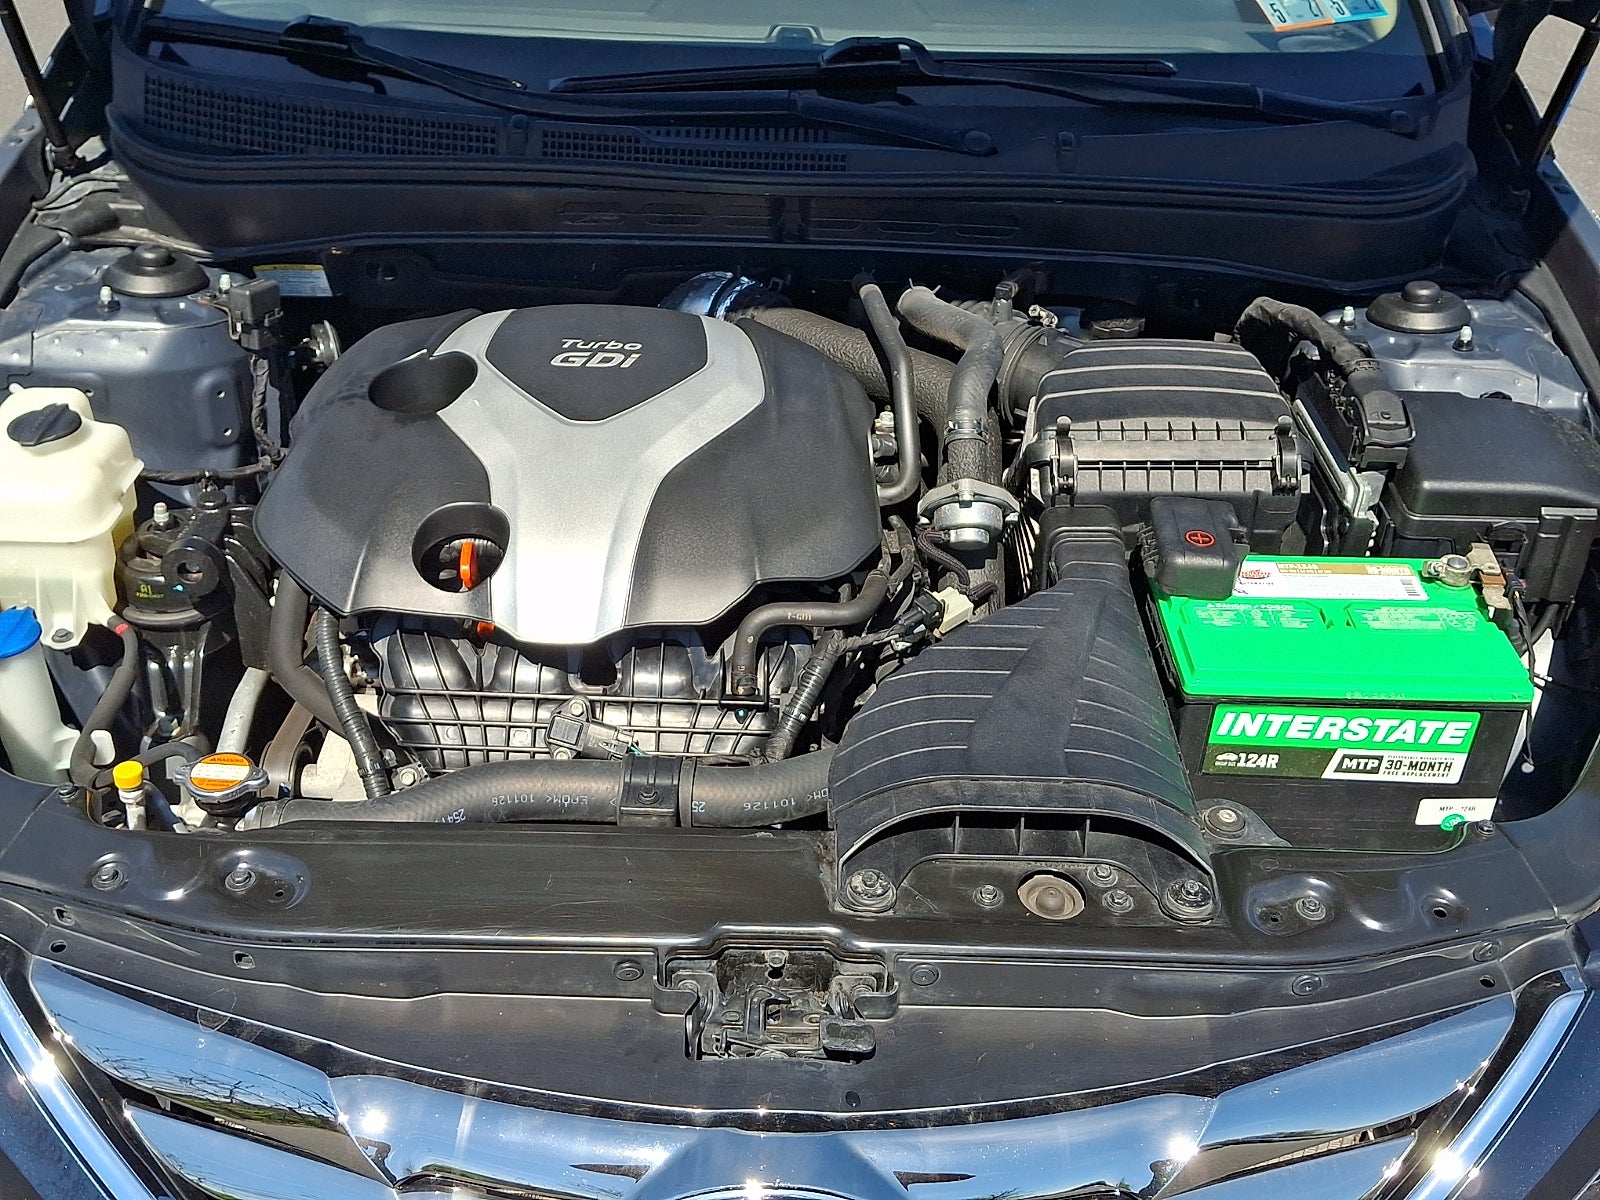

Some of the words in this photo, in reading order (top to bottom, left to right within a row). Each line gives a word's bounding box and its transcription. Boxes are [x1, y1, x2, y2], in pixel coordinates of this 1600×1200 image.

[561, 338, 642, 350] Turbo
[550, 351, 642, 368] GDi
[1216, 711, 1473, 746] INTERSTATE
[1237, 752, 1280, 769] 124R
[1342, 758, 1380, 770] MTP
[1385, 759, 1453, 773] 30-MONTH
[491, 793, 535, 807] 101126
[743, 797, 796, 811] 101126
